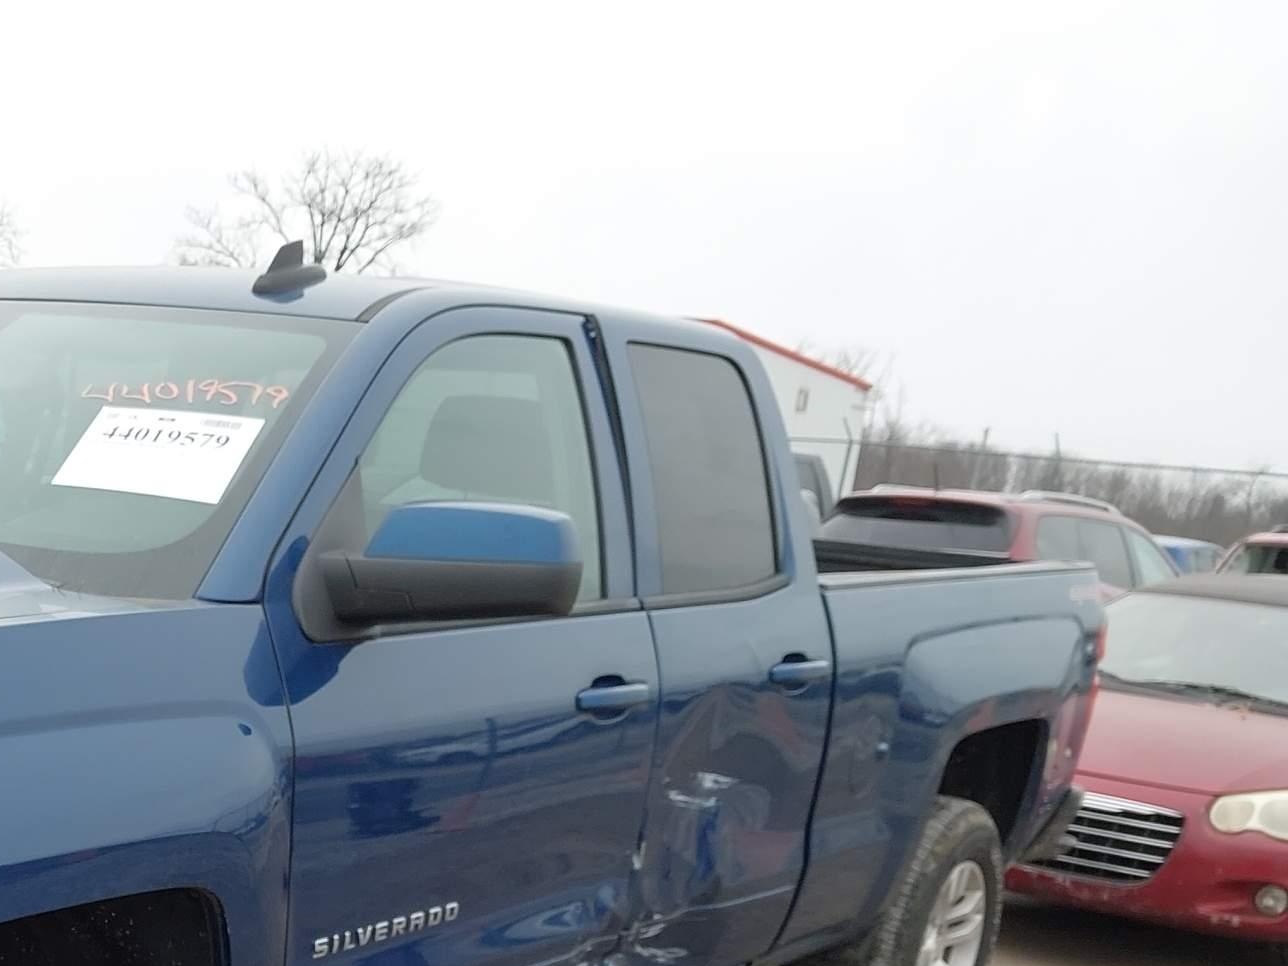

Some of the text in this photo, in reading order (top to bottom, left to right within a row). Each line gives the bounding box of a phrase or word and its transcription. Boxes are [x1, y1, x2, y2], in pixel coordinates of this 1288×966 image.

[81, 379, 289, 408] 44019579
[103, 426, 230, 448] 44019579
[312, 901, 460, 959] SILVERADO
